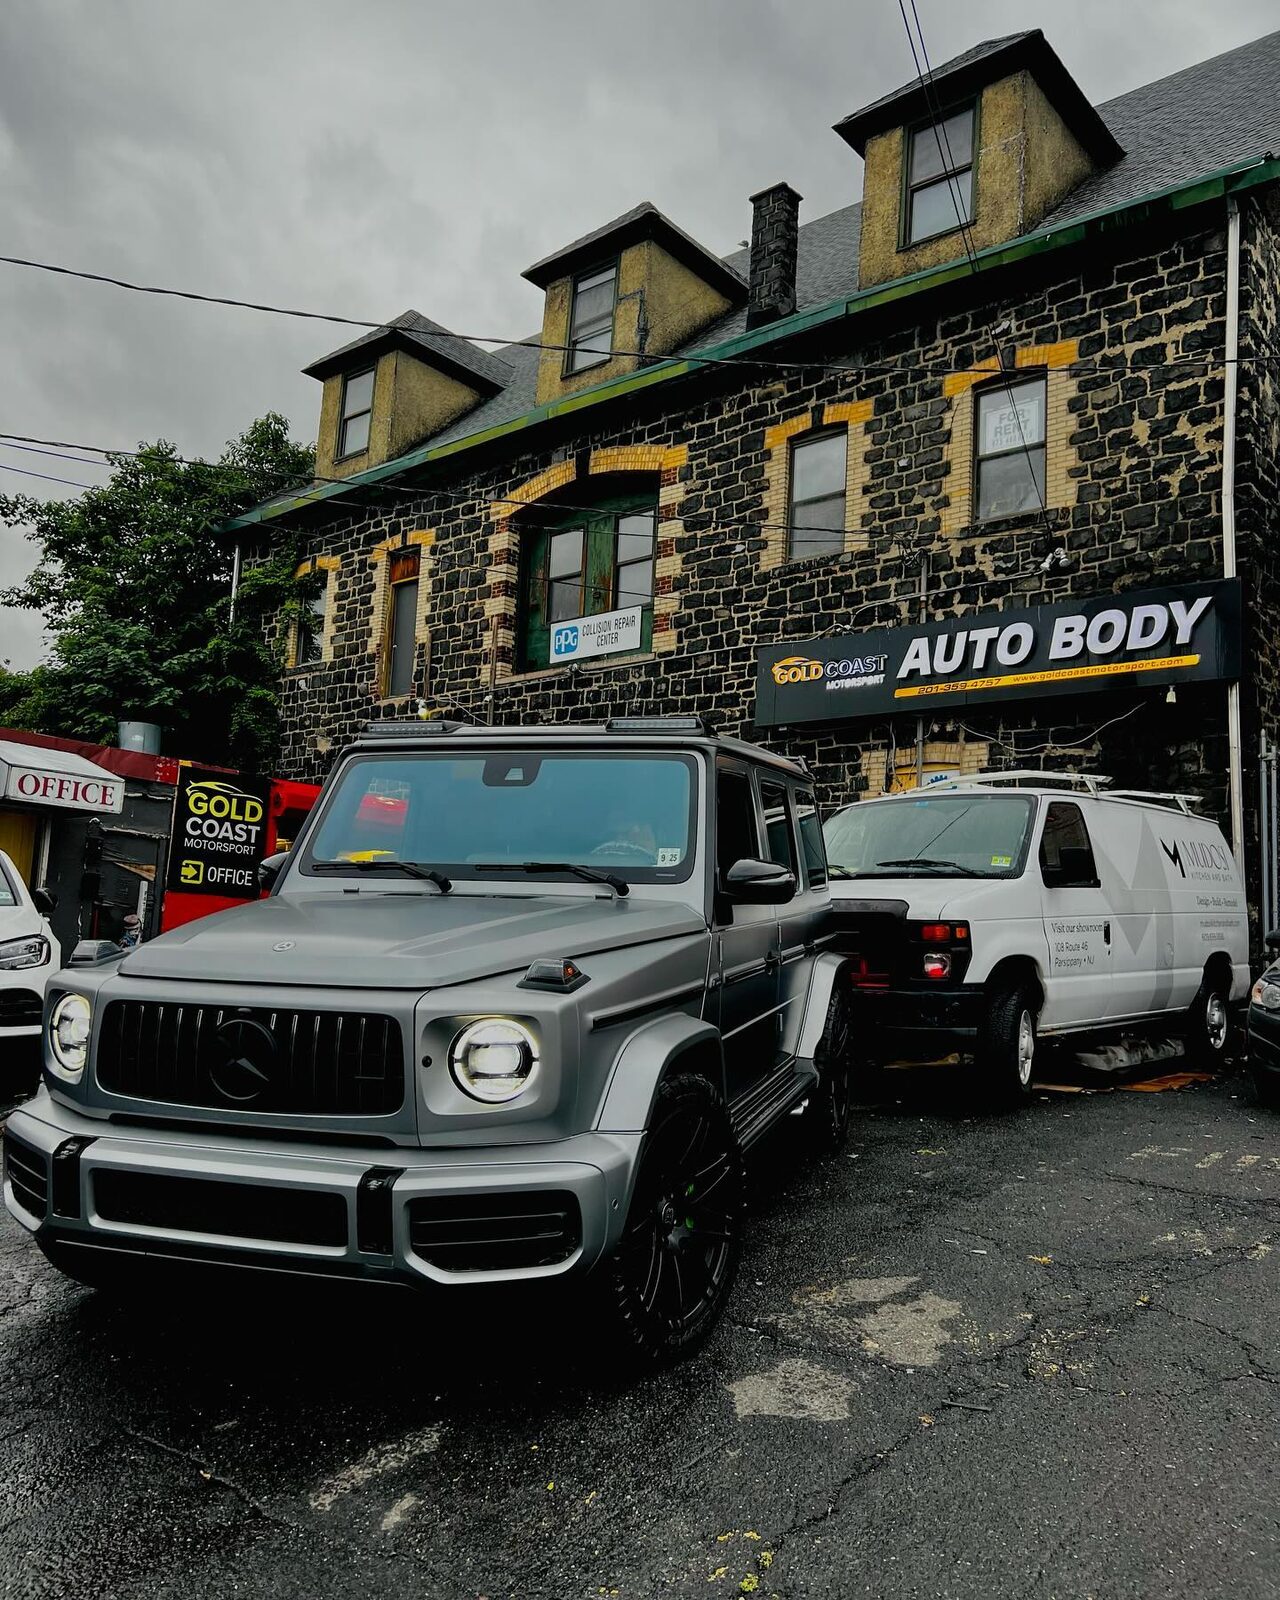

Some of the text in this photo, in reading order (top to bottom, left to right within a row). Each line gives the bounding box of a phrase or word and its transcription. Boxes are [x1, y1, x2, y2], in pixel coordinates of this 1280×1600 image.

[999, 409, 1025, 423] FOR
[994, 419, 1030, 438] RENT
[582, 615, 636, 637] COLLISION REPAIR
[555, 630, 578, 652] PPG
[596, 632, 619, 647] CENTER
[896, 596, 1213, 679] AUTO BODY
[774, 654, 888, 685] GOLD COAST
[1012, 657, 1184, 681] www.goldcoastmotorsport.com
[826, 674, 886, 690] MOTORSPORT
[18, 773, 115, 807] OFFICE
[188, 791, 263, 823] GOLD
[186, 817, 261, 843] COAST
[184, 837, 256, 856] MOTORSPORT
[661, 853, 678, 862] 9 25
[207, 866, 253, 887] OFFICE
[1051, 922, 1103, 934] Visit our showroom
[1065, 942, 1080, 952] Route
